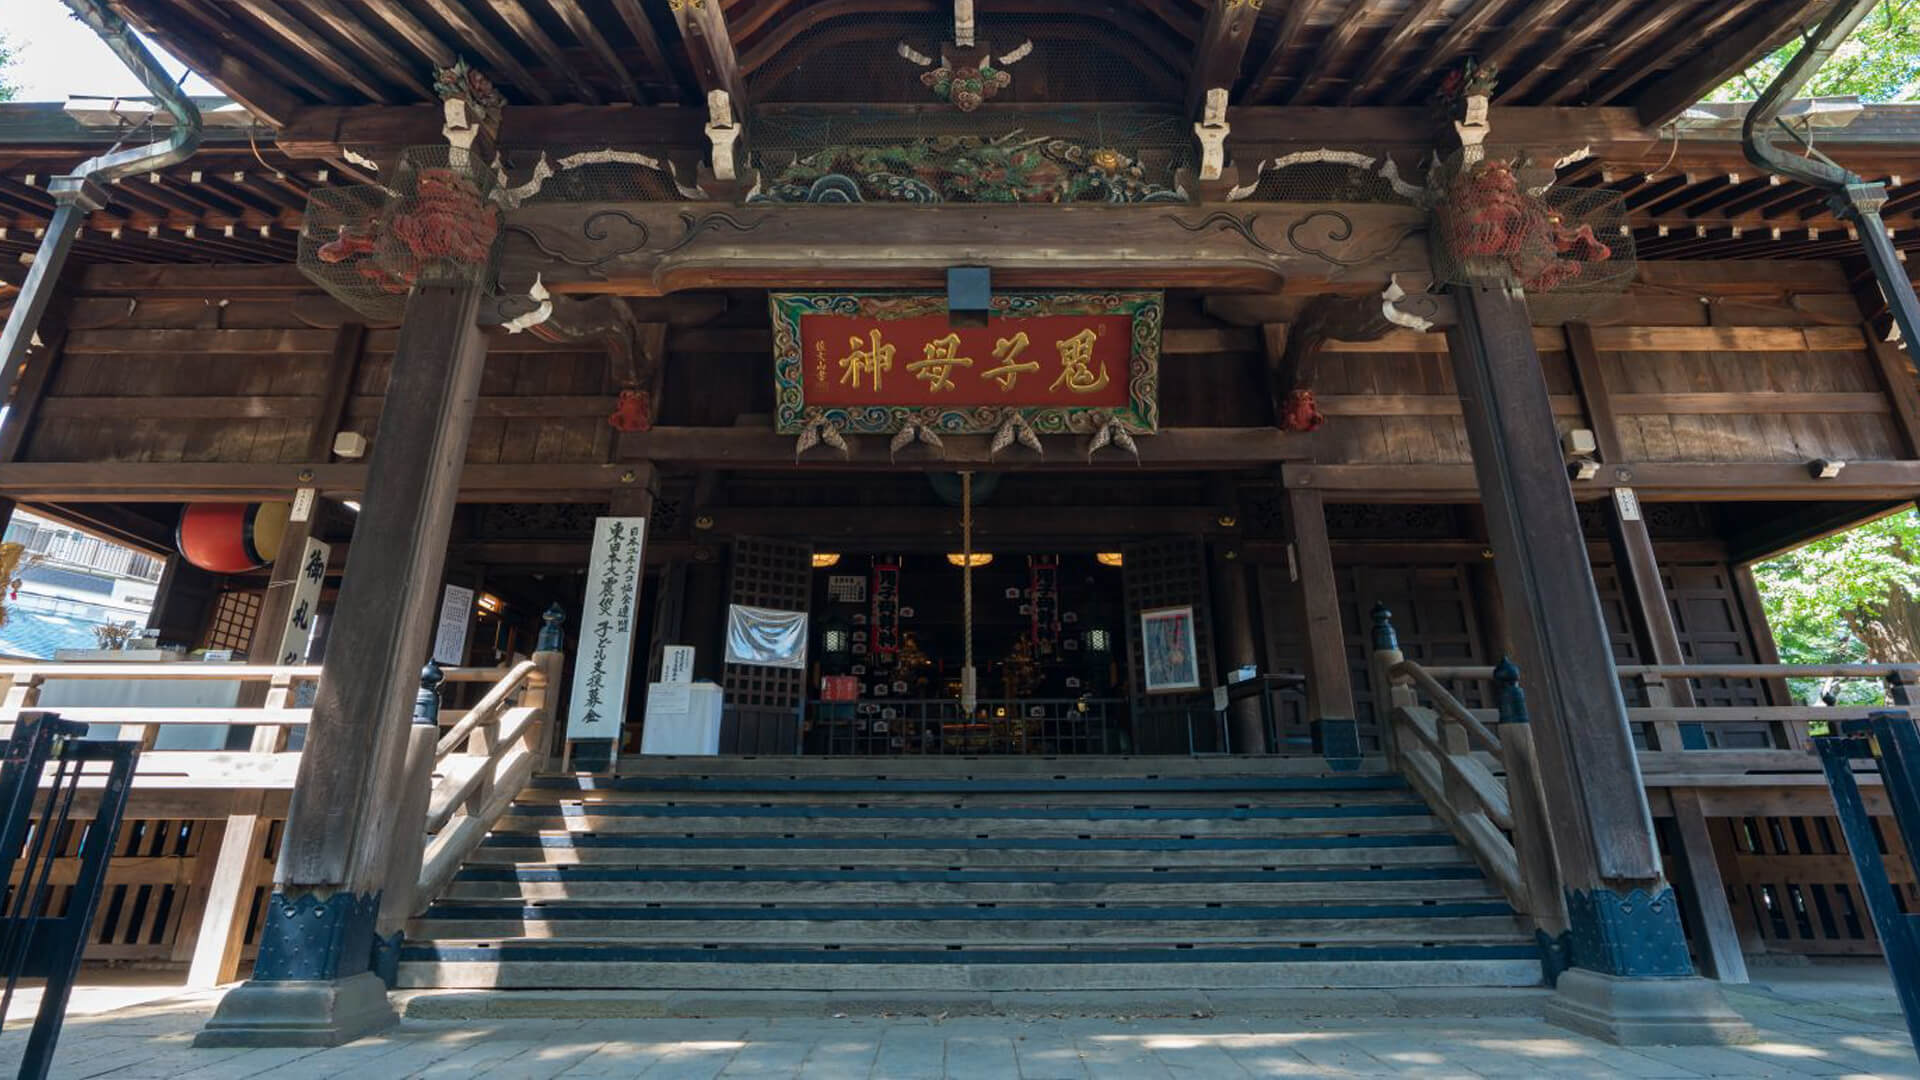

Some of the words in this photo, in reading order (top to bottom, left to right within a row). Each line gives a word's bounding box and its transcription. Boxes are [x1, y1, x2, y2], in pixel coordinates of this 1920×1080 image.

[616, 526, 640, 633] 日本ユネスコ協会連盟
